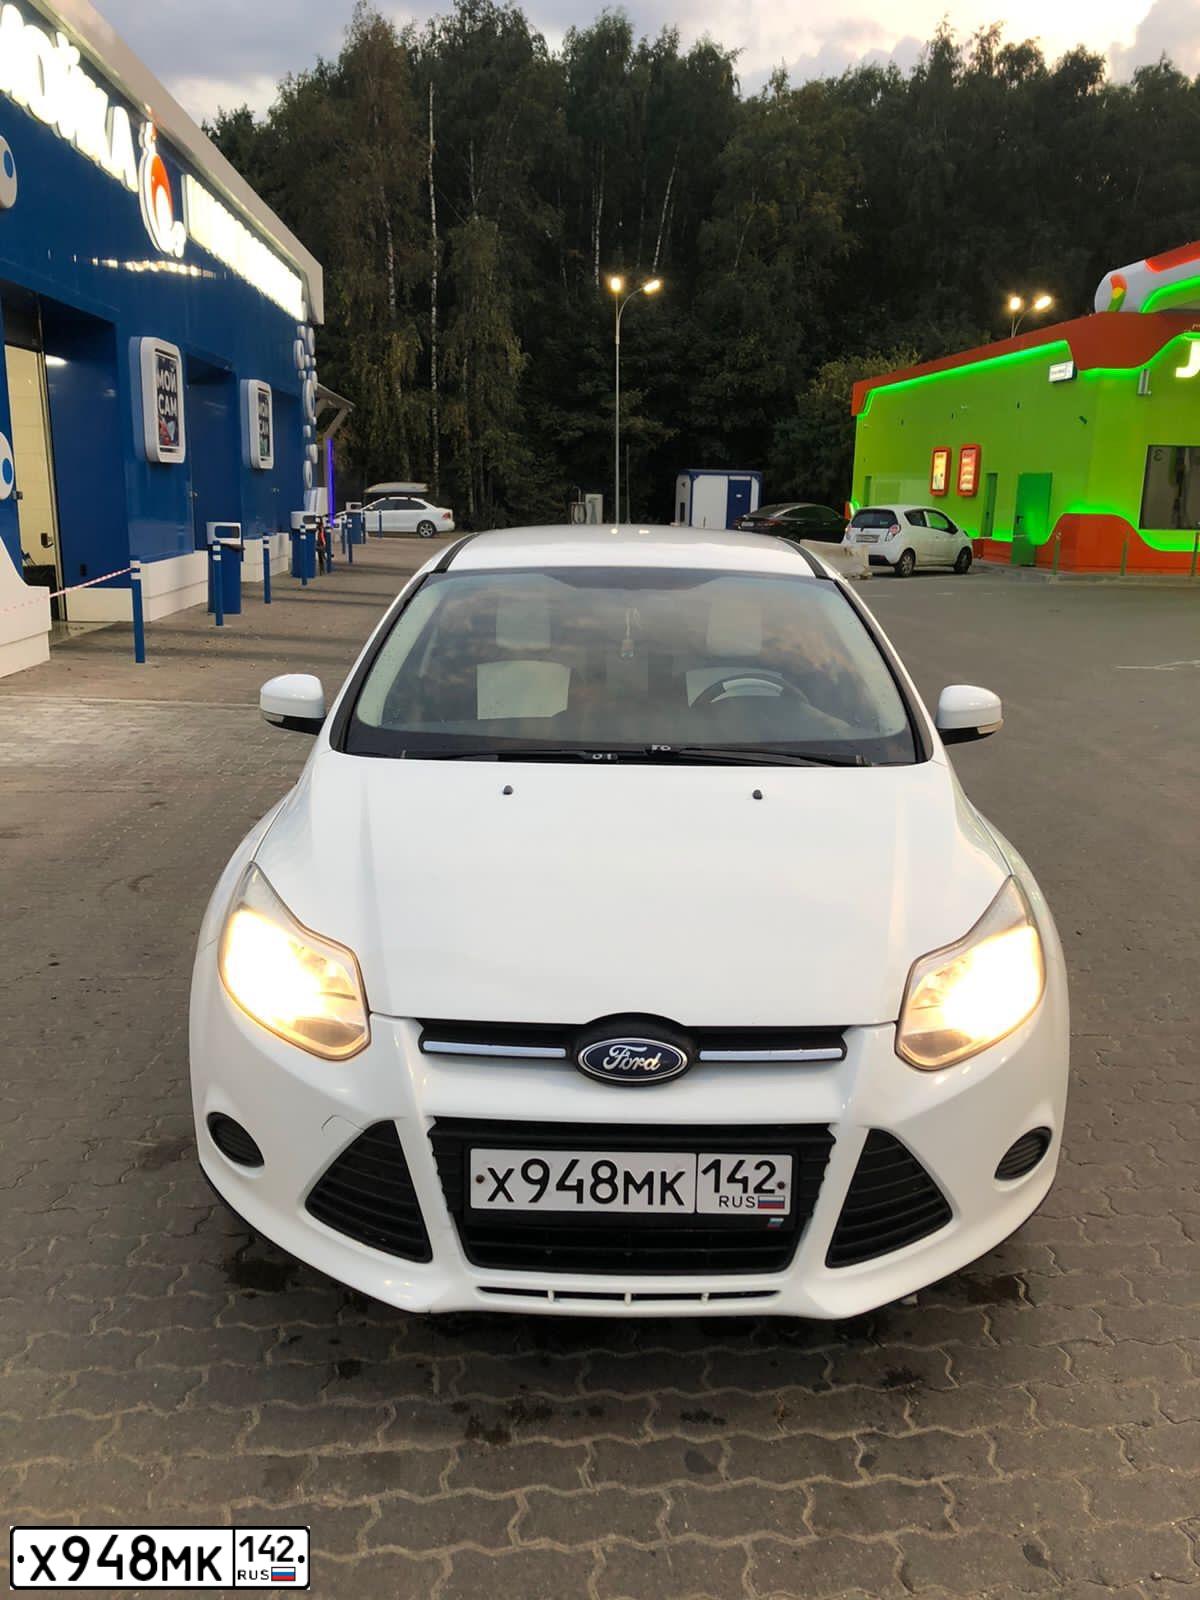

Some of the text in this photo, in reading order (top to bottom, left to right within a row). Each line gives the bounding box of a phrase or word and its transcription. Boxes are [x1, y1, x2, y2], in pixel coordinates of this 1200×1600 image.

[603, 1044, 662, 1070] Ford
[701, 1158, 777, 1195] 142
[718, 1195, 756, 1209] RUS
